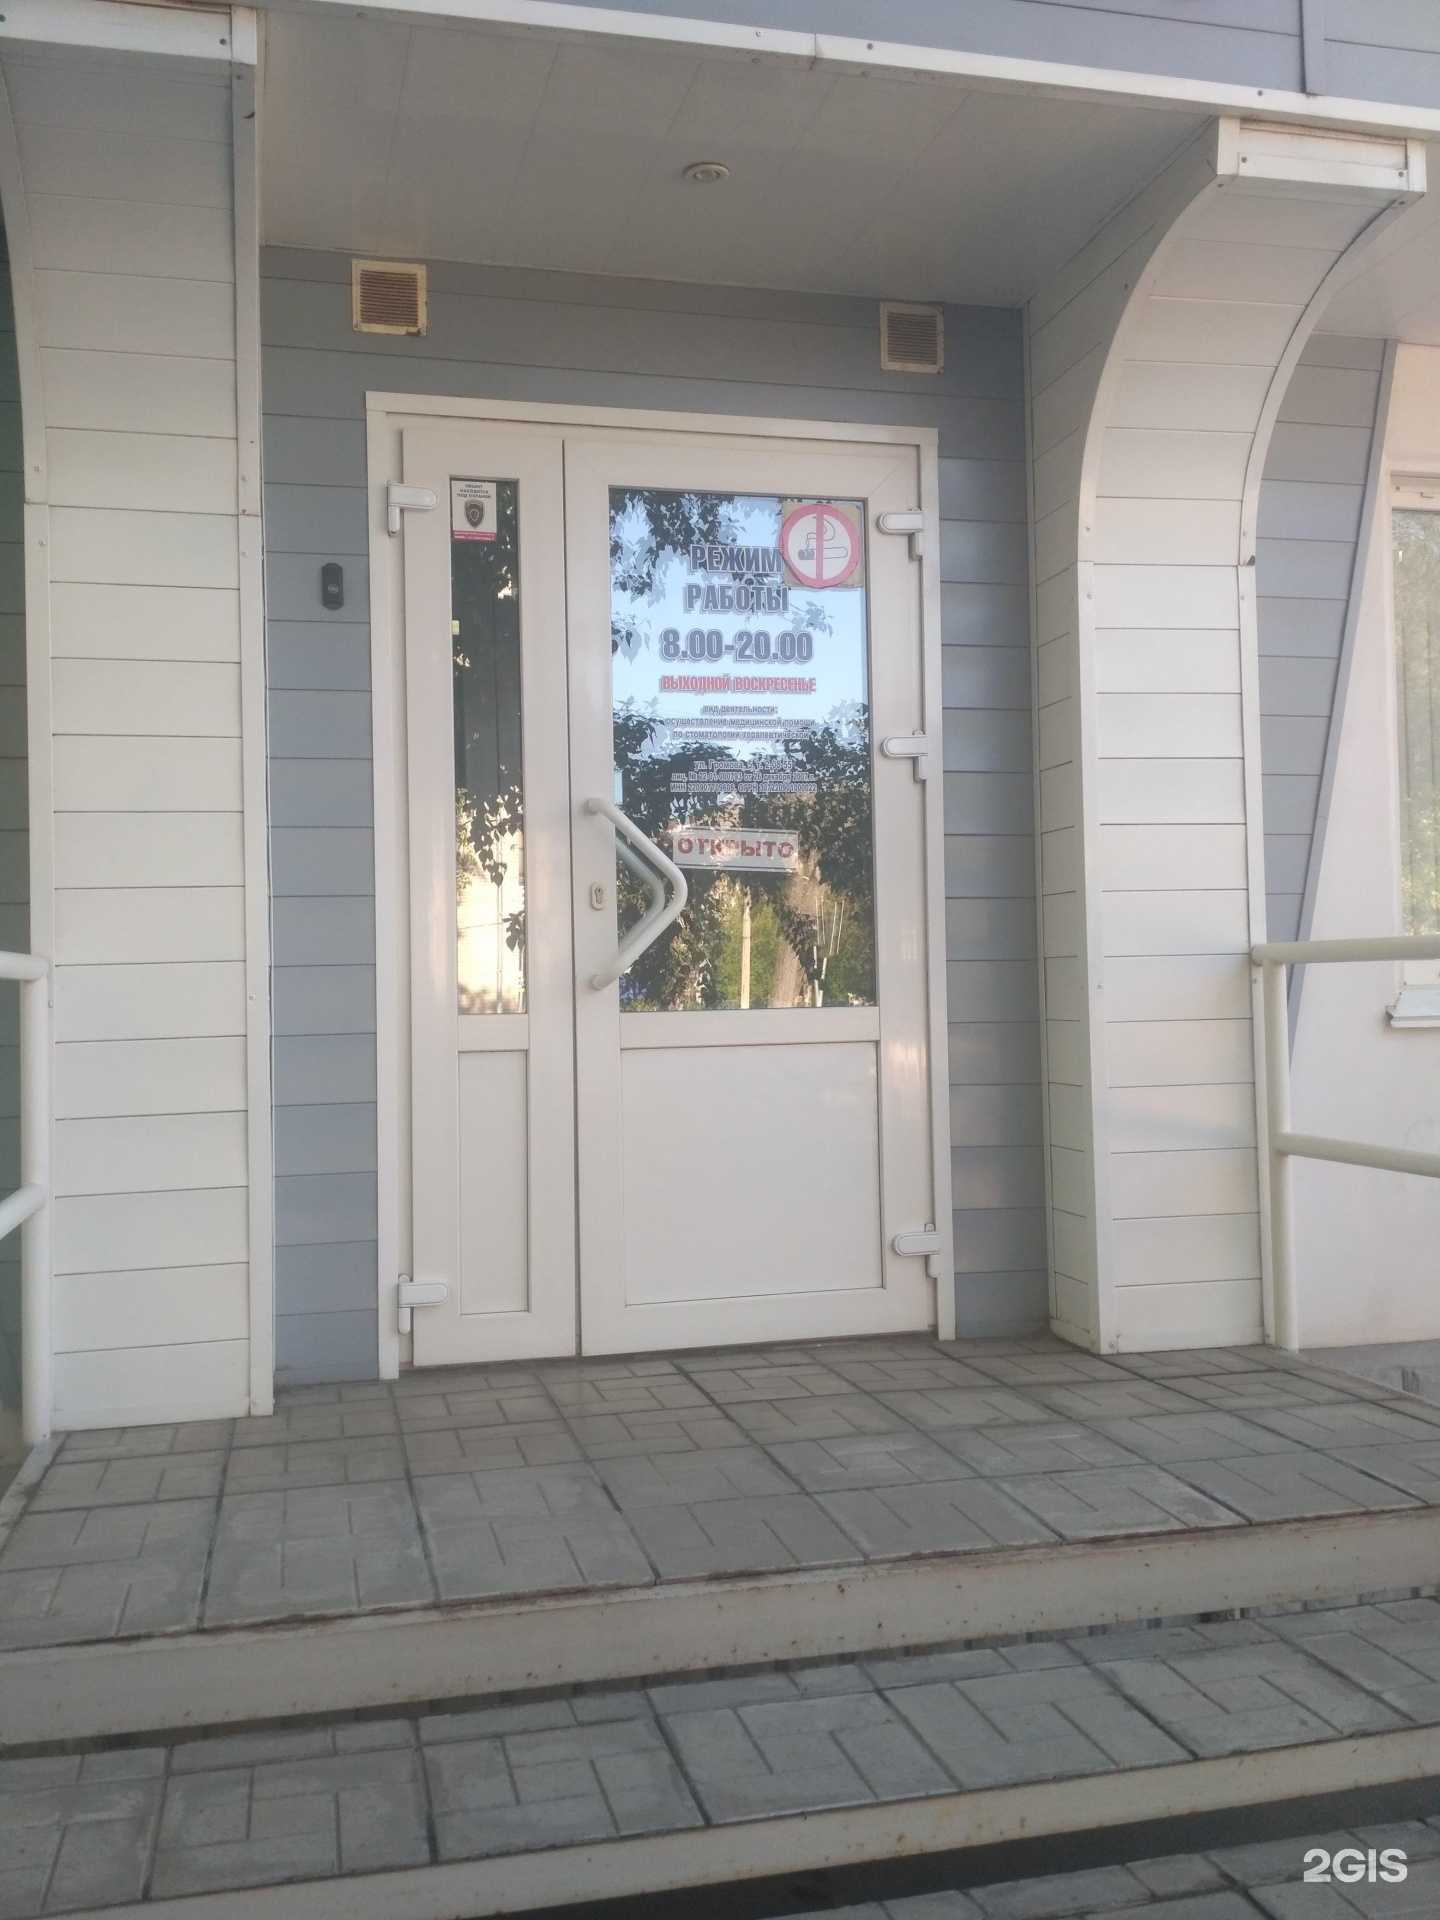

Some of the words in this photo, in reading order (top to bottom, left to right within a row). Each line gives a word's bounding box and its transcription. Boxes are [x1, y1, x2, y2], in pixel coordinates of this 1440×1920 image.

[689, 544, 785, 574] РЕЖИМ
[686, 583, 790, 613] РАБОТЫ
[660, 629, 815, 663] 8.00-20.00
[660, 674, 730, 695] ВЫХОДНОЙ
[733, 676, 816, 694] ВОСКРЕСЕНЬЕ
[677, 837, 794, 858] ОТКРЫТО
